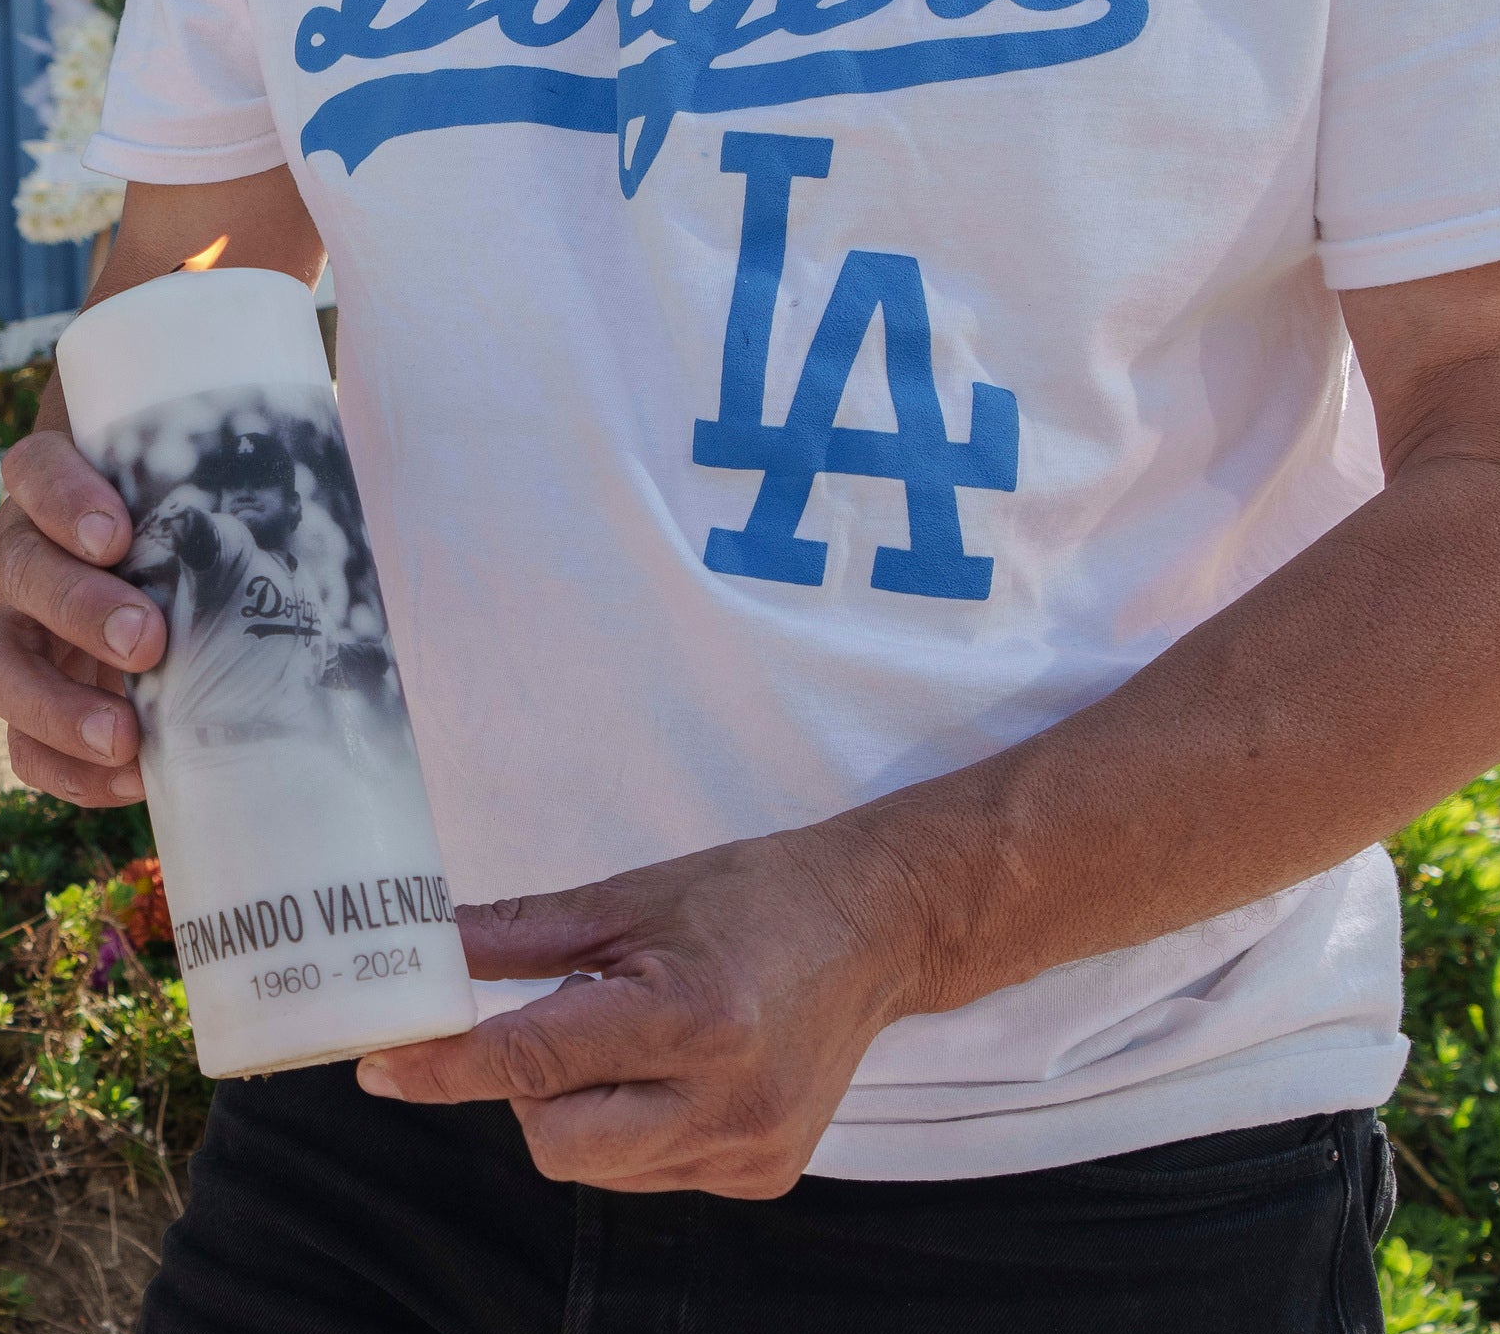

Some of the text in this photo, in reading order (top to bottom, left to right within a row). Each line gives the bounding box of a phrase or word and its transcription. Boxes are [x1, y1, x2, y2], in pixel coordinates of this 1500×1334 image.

[692, 130, 1020, 601] LA
[174, 894, 304, 973] FERNANDO
[250, 963, 321, 1001] 1960
[353, 947, 422, 982] 2024
